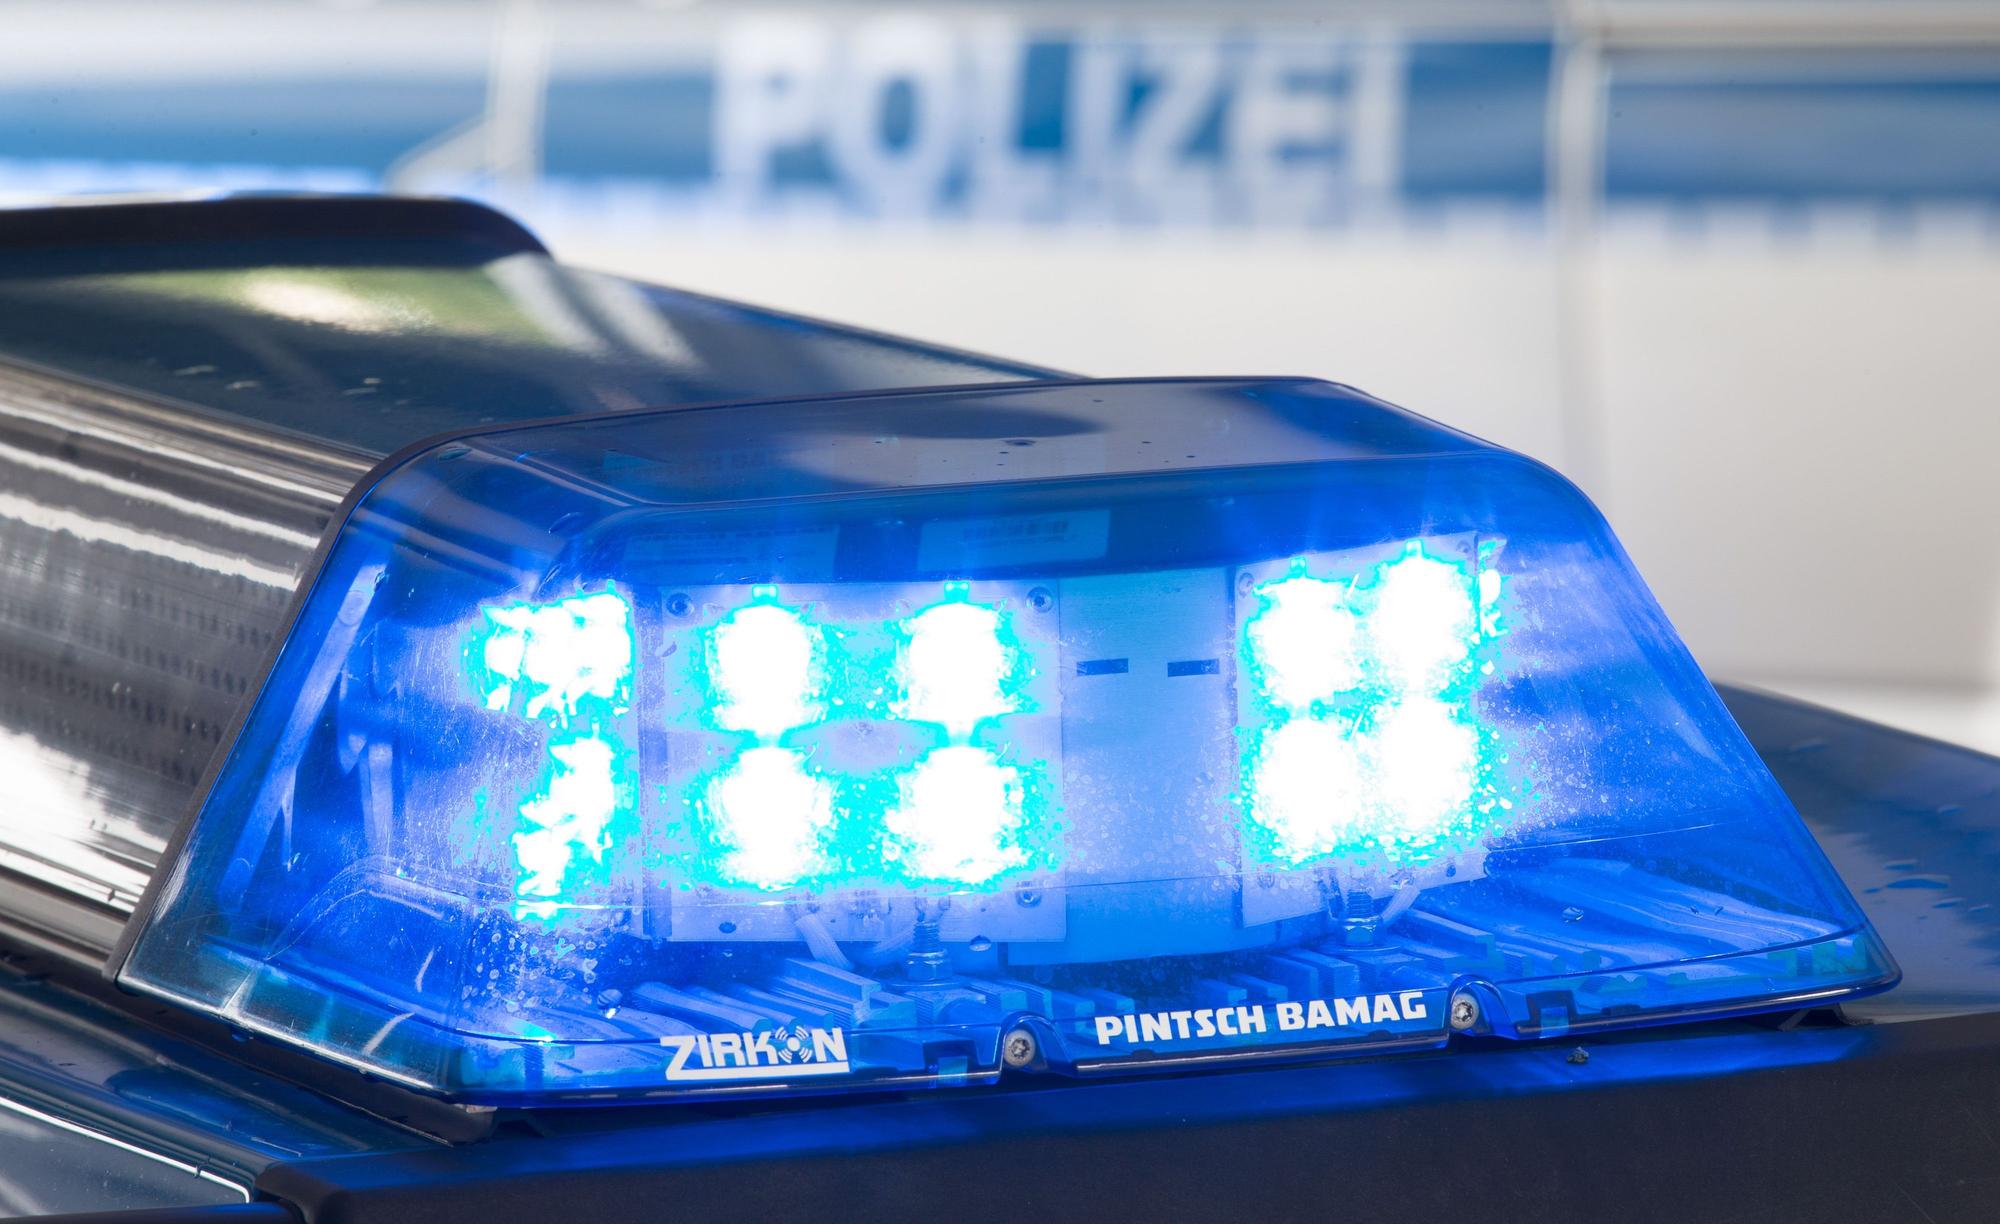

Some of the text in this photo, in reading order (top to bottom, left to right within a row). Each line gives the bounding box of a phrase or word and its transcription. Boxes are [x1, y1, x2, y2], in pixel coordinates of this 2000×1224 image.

[712, 20, 1406, 222] POLIZEI
[1095, 992, 1427, 1045] PINTSCH BAMAG
